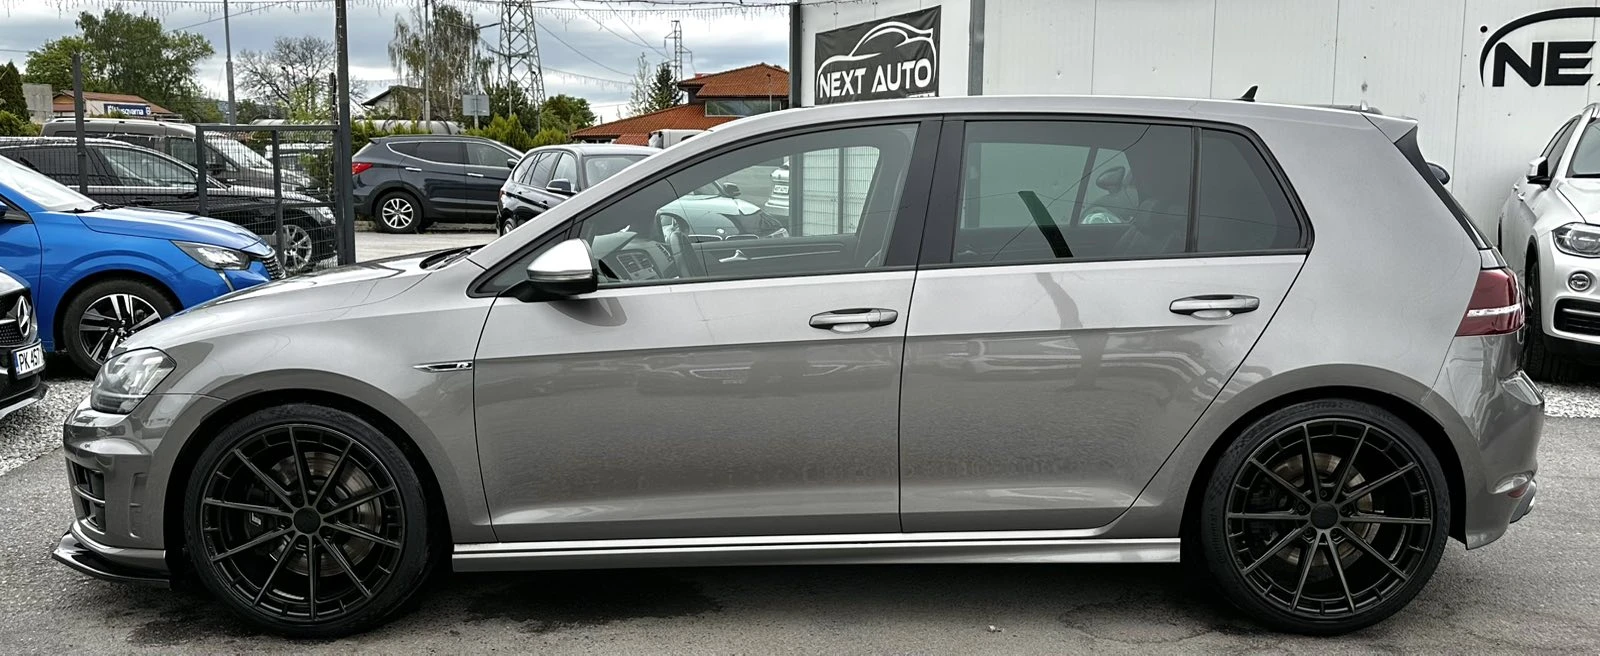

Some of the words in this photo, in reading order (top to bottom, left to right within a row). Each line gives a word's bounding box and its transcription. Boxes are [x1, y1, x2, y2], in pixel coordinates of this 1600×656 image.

[819, 68, 866, 98] NEXT
[872, 58, 932, 92] AUTO
[1492, 41, 1600, 87] NE
[19, 351, 31, 371] PK
